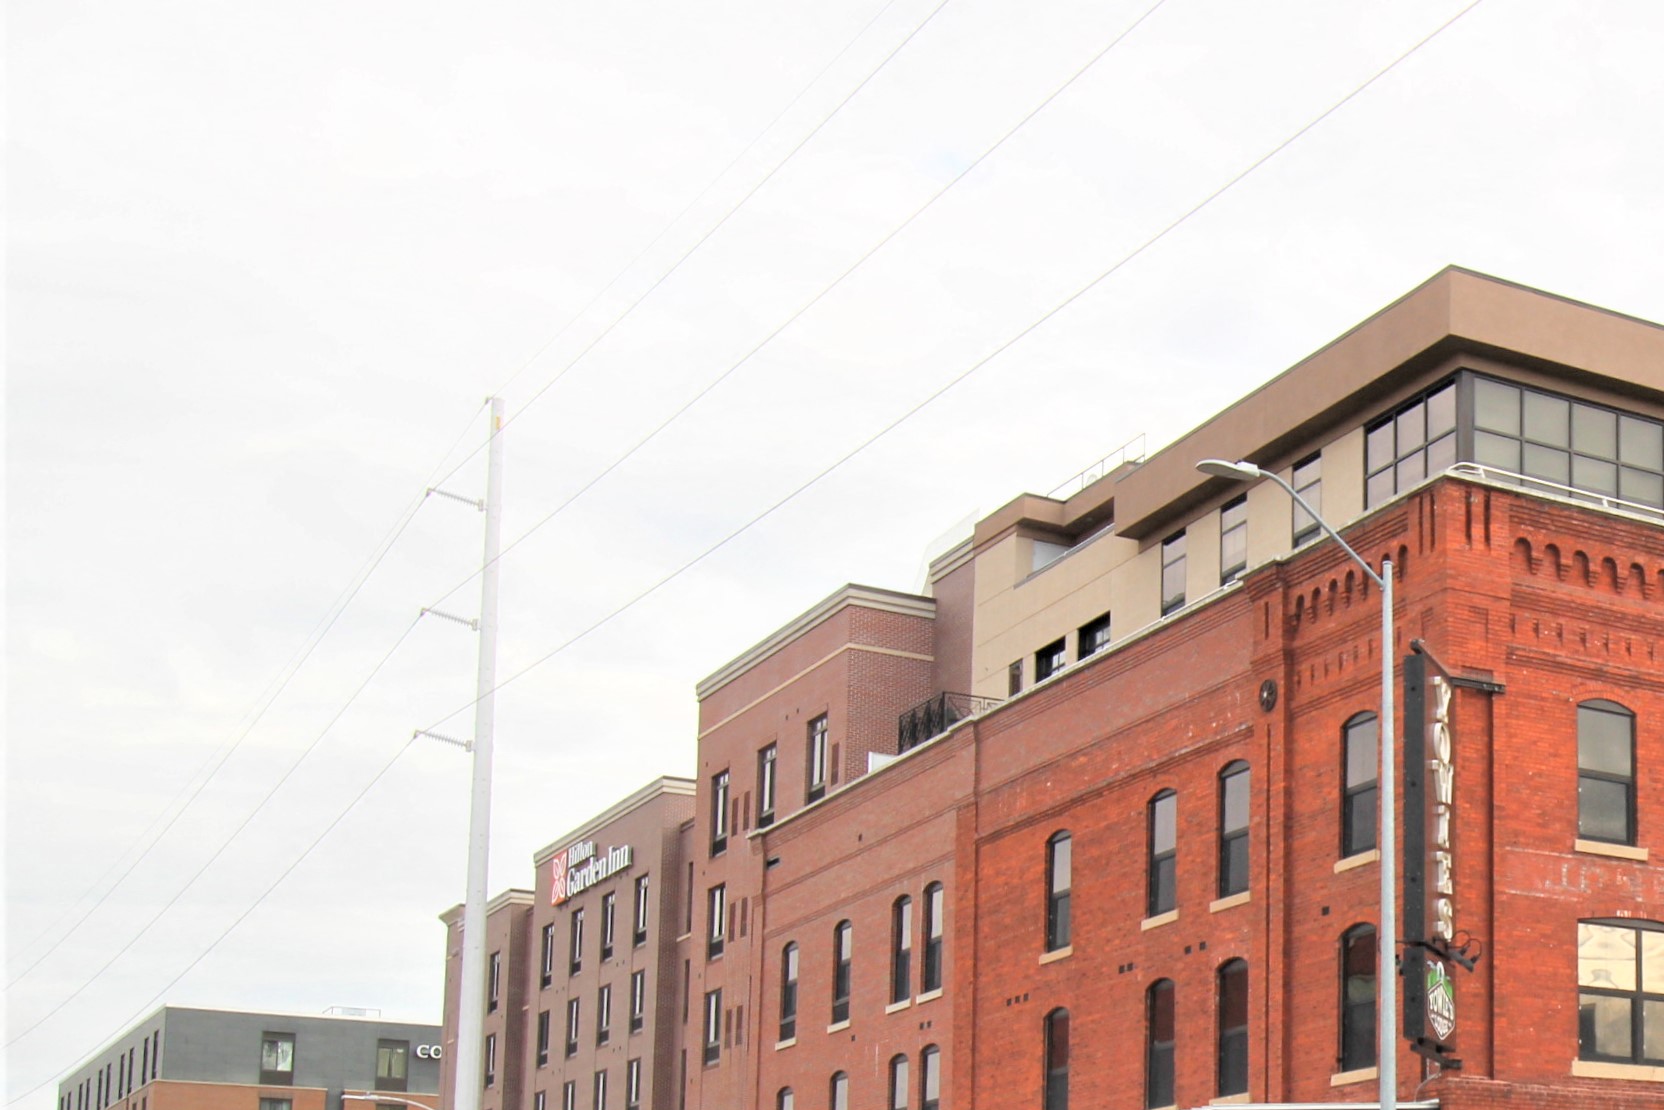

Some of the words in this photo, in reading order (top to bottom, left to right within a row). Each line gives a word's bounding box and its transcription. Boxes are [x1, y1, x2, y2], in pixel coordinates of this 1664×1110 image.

[566, 856, 606, 897] Garden
[608, 845, 630, 876] Inn
[568, 841, 594, 868] Hilton
